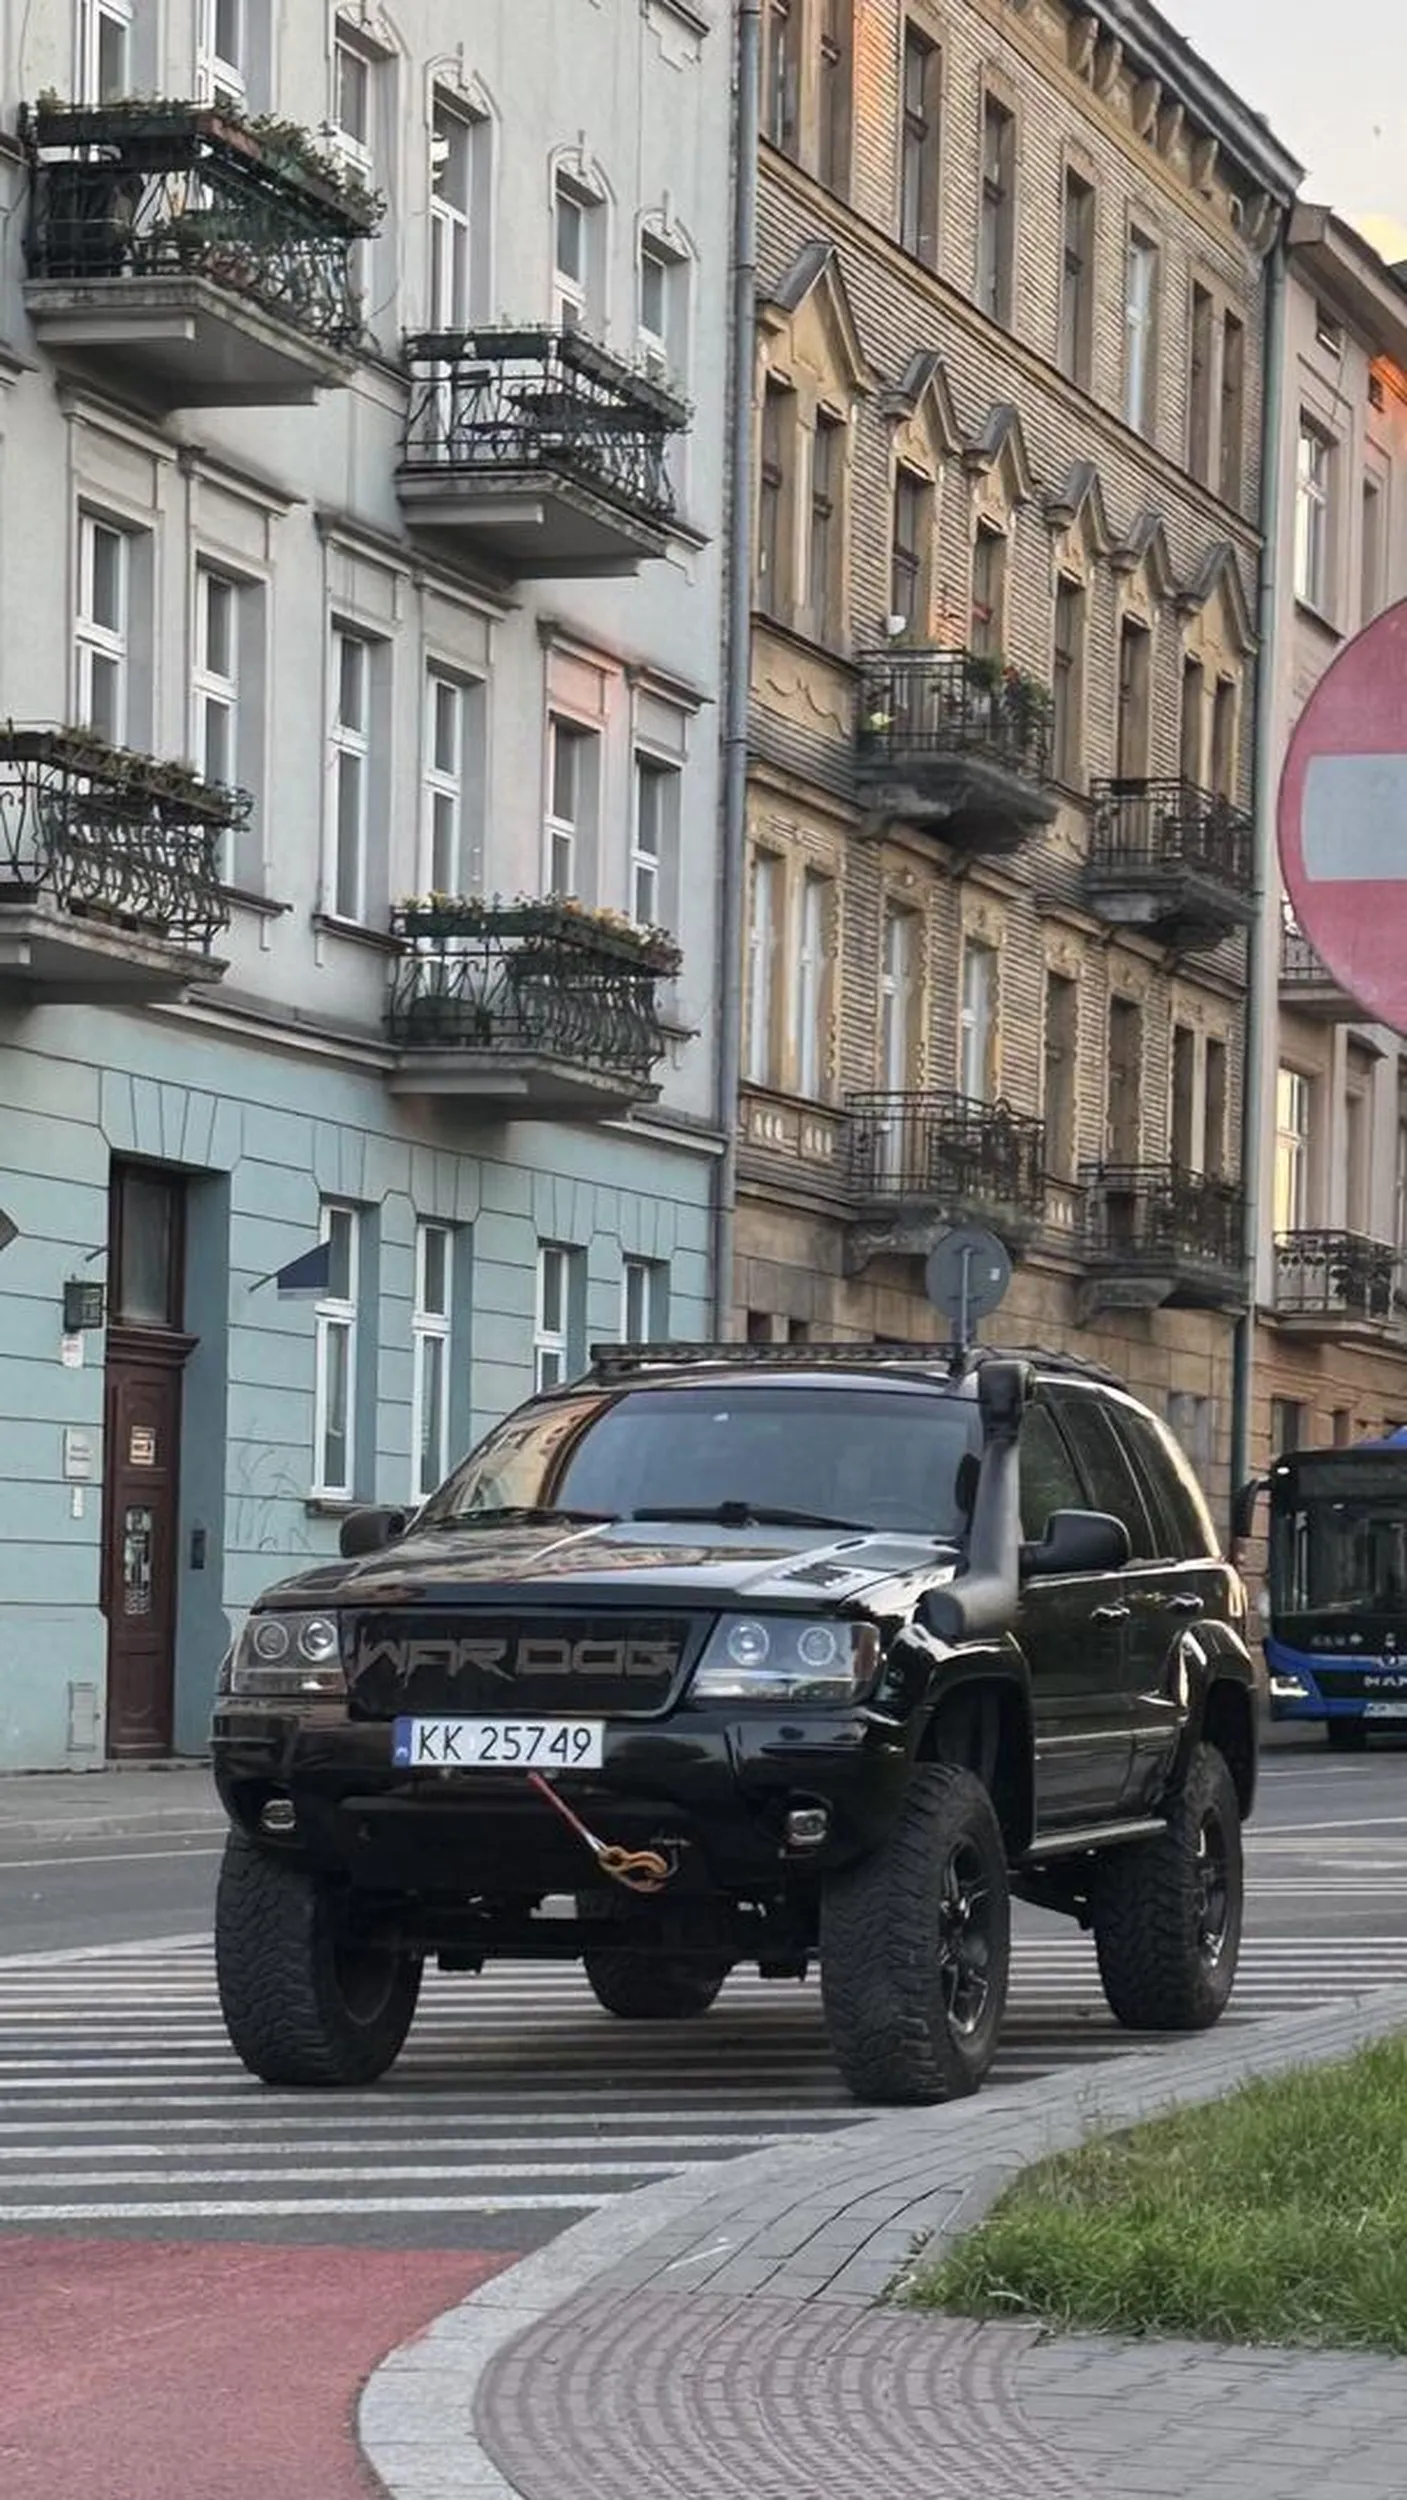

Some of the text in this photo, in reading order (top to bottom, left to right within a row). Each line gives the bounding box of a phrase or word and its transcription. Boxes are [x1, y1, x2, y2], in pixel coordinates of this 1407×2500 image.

[350, 1627, 681, 1688] WAR DOG
[418, 1725, 592, 1763] KK 25749
